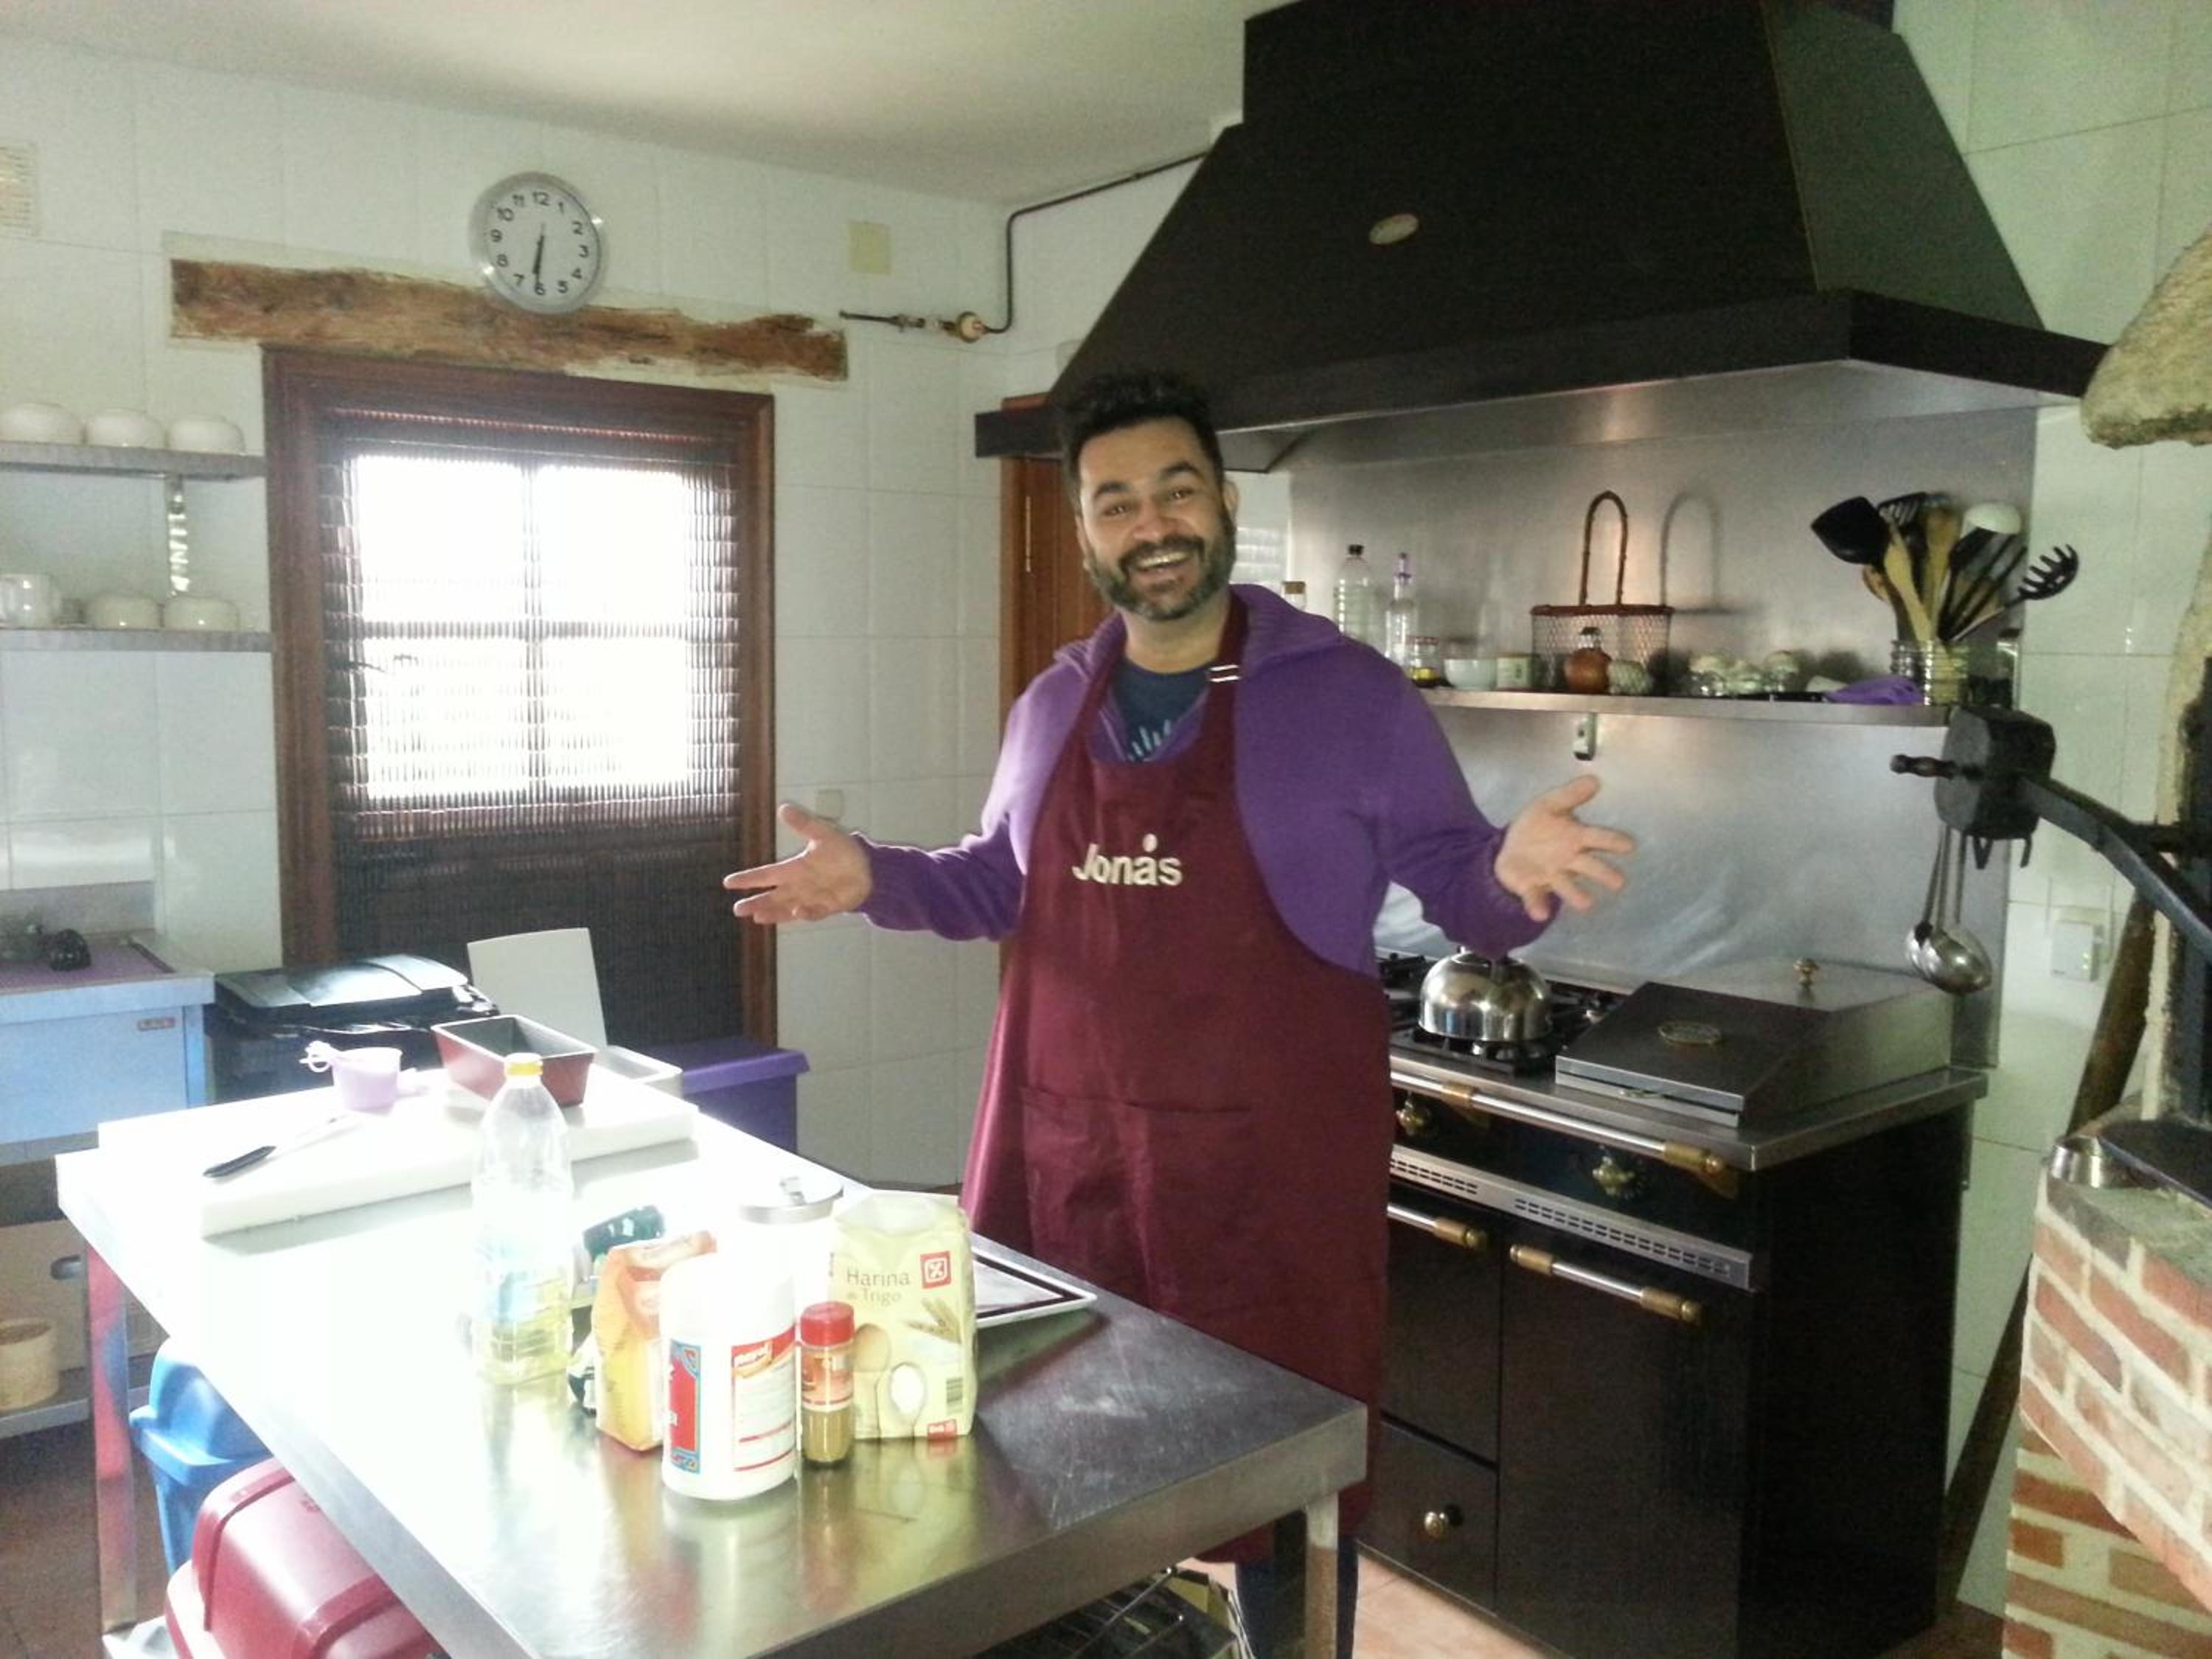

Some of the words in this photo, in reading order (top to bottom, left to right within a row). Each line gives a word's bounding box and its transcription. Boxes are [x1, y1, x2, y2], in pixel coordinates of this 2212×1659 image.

[512, 195, 524, 207] 11
[533, 192, 550, 206] 12
[497, 207, 514, 221] 10
[558, 201, 564, 214] 1
[571, 221, 582, 235] 2
[490, 229, 502, 242] 9
[579, 245, 588, 258] 3
[497, 254, 508, 267] 8
[514, 274, 524, 285] 7
[571, 268, 582, 279] 4
[535, 282, 546, 296] 6
[558, 281, 568, 293] 5
[846, 1265, 910, 1287] Harina
[861, 1288, 902, 1307] Trigo
